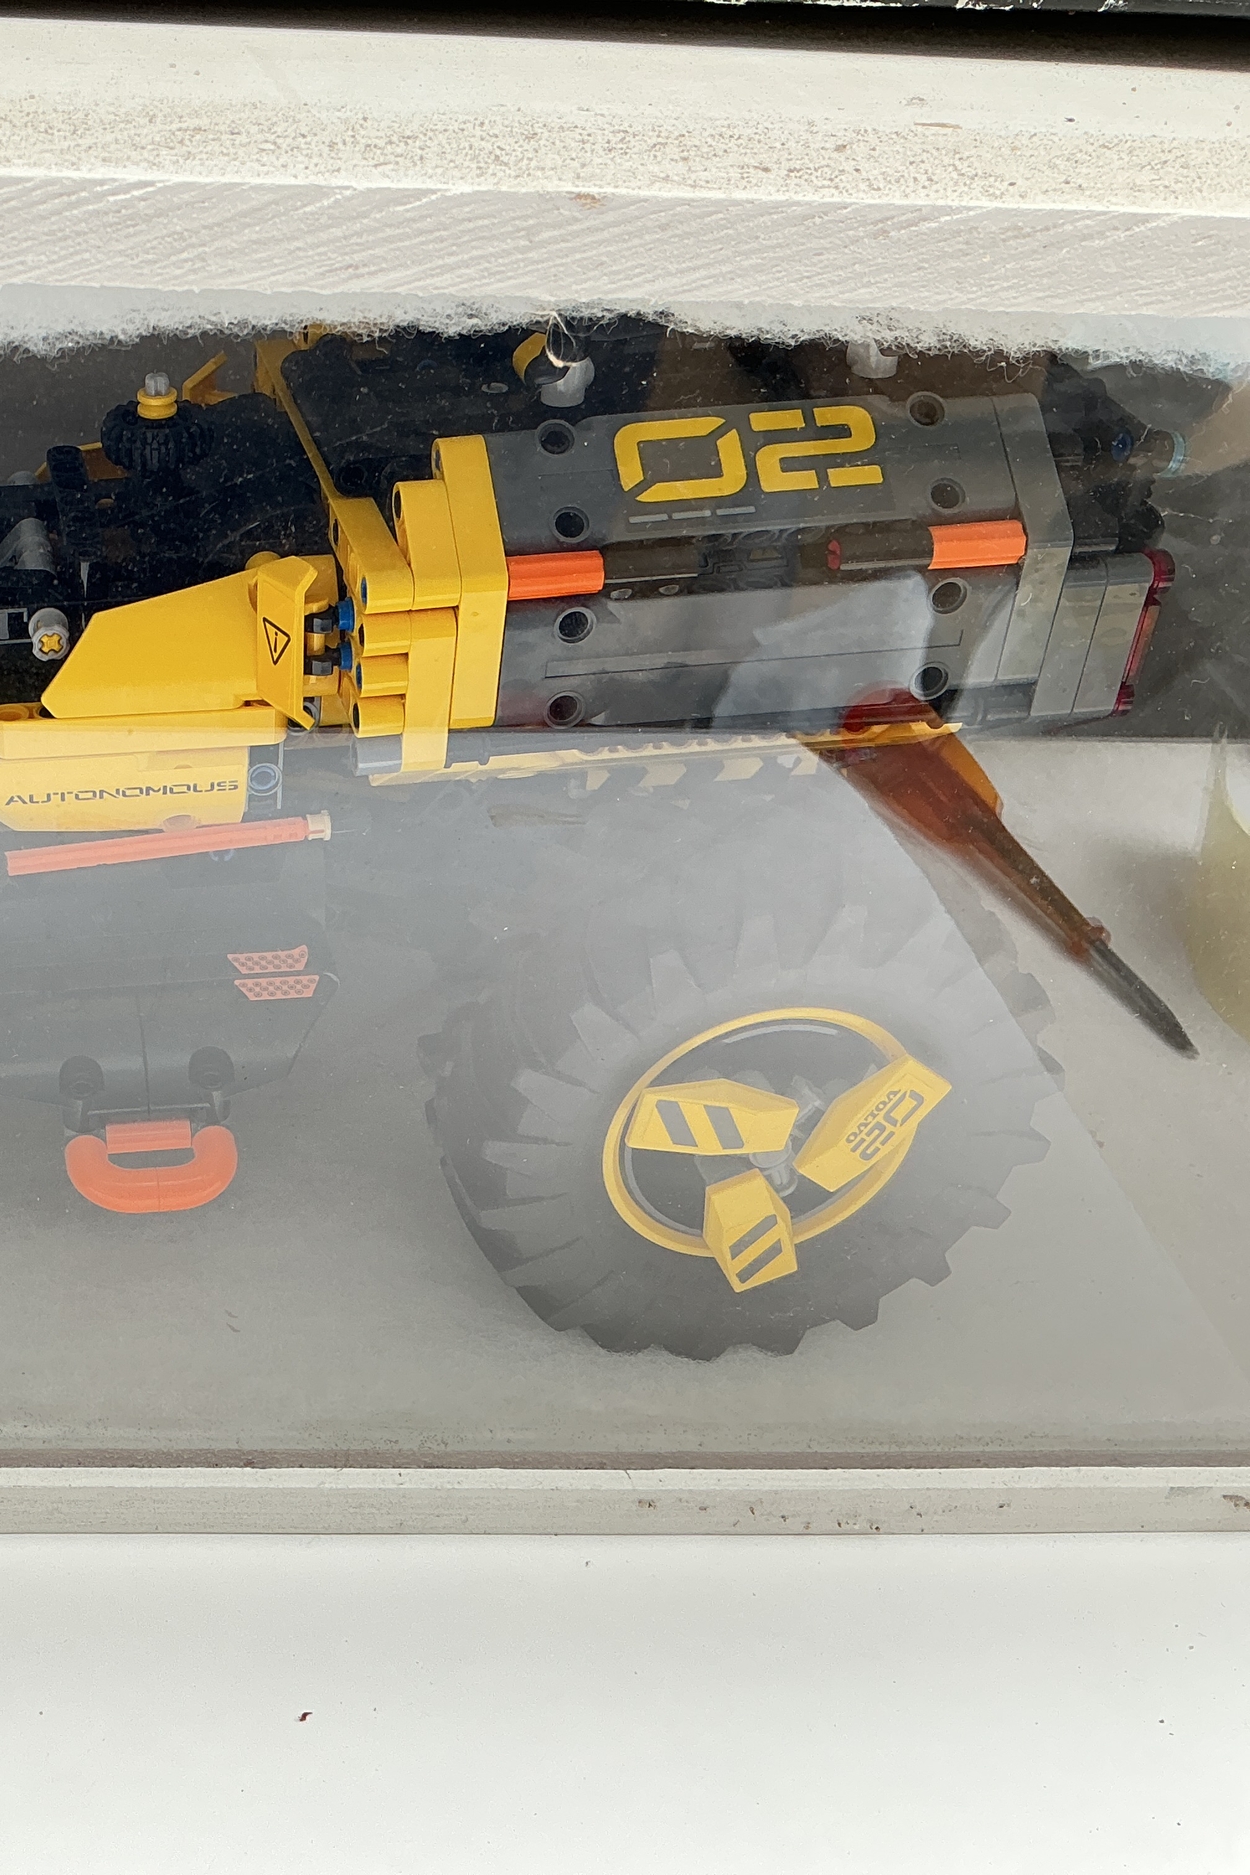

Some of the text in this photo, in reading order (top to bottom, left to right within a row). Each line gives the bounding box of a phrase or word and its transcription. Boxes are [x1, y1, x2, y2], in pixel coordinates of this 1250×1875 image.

[614, 405, 883, 502] 02
[5, 780, 239, 806] AUTONOMOUS
[845, 1089, 901, 1144] VOLVO
